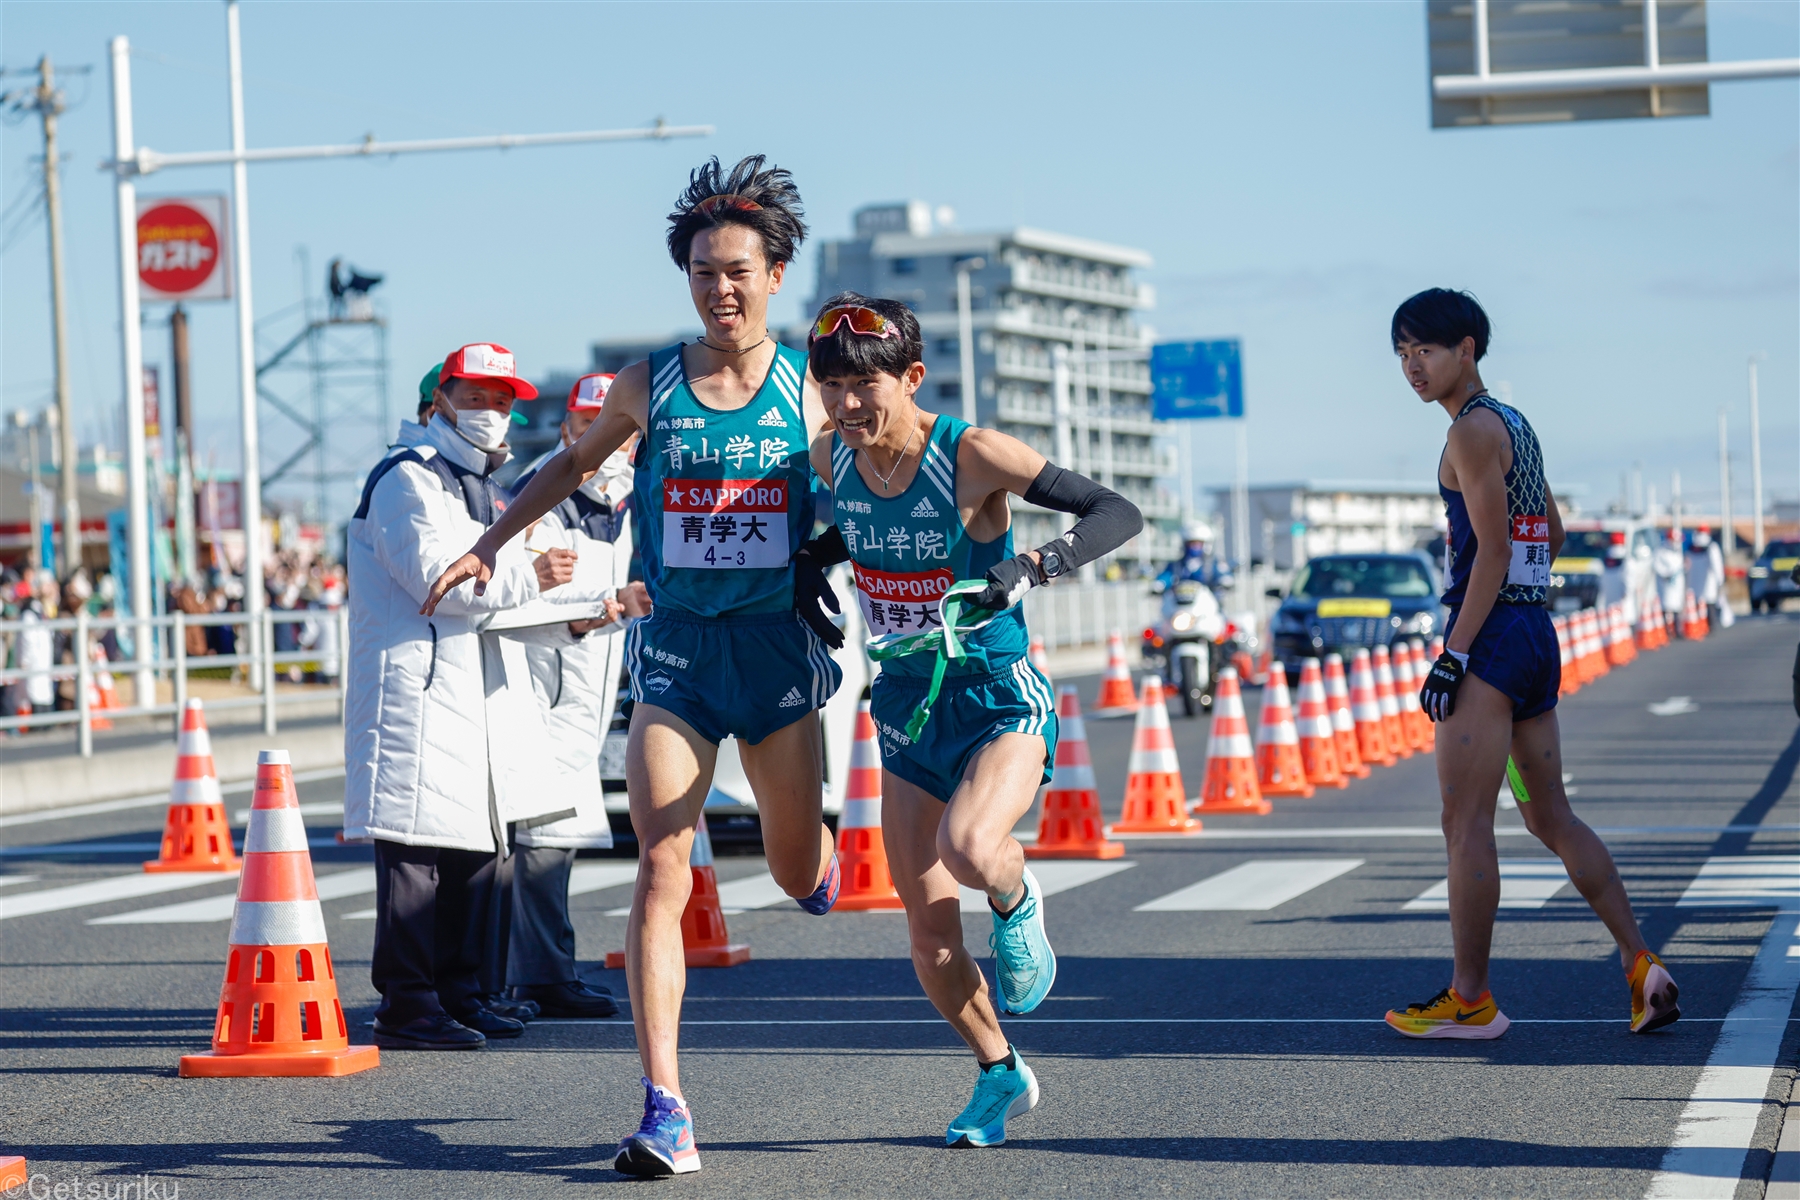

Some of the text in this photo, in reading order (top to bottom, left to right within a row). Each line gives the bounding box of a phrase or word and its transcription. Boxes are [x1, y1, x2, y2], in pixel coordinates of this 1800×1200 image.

[140, 239, 214, 272] ガスト
[671, 417, 706, 430] 妙高市
[757, 418, 788, 428] adidas
[661, 434, 791, 471] 青山学院
[689, 487, 783, 507] SAPPORO
[846, 500, 872, 515] 妙高市
[910, 509, 940, 518] adidas
[681, 515, 768, 544] 青学大
[841, 518, 949, 561] 青山学院
[704, 545, 746, 566] 4-3
[865, 576, 950, 598] SAPPORO
[868, 598, 943, 629] 青学大
[654, 648, 690, 669] 妙高市
[778, 697, 806, 708] adidas
[882, 722, 912, 746] 妙高市
